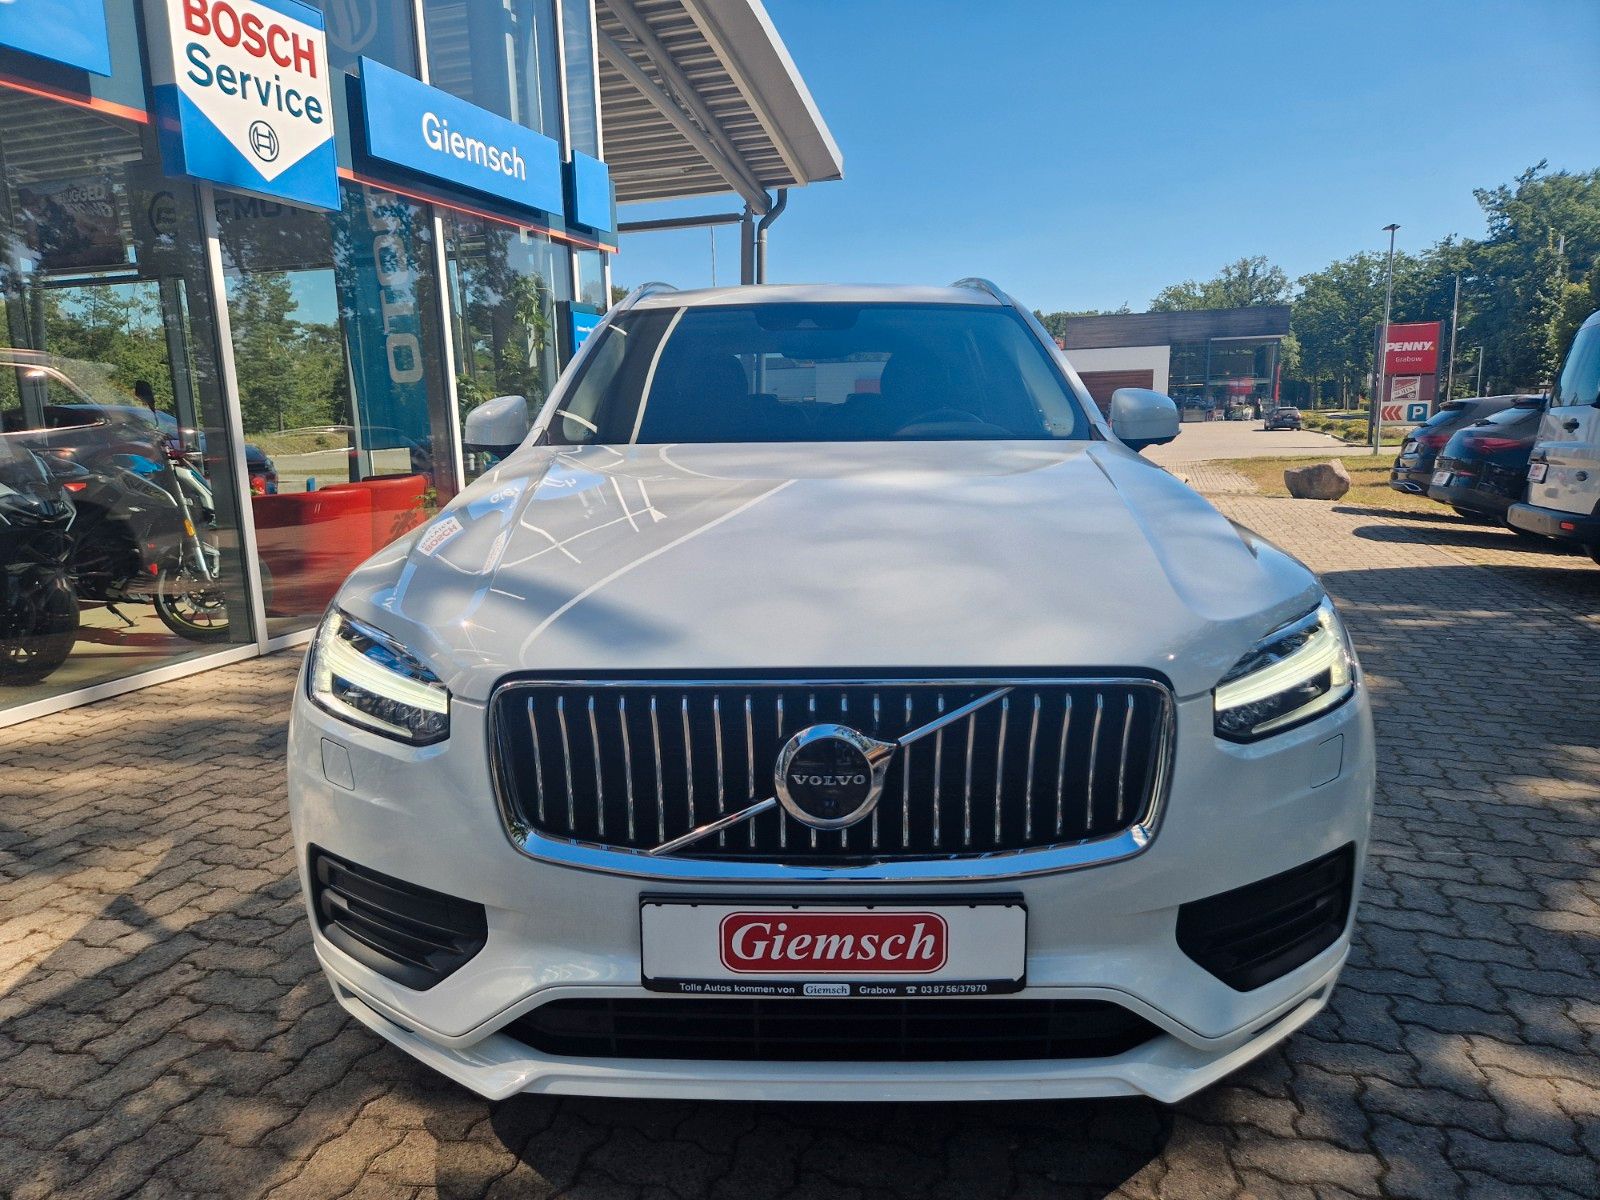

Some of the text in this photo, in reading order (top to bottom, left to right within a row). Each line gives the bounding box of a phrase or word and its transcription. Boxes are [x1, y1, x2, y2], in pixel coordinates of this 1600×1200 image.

[182, 0, 317, 79] BOSCH
[186, 42, 324, 124] Service
[422, 111, 526, 181] Giemsch
[1395, 355, 1423, 363] Grabow
[1411, 405, 1424, 419] P
[791, 774, 866, 786] VOLVO
[731, 922, 936, 960] Giemsch
[679, 982, 702, 992] Tolle
[704, 983, 732, 992] Autos
[734, 984, 775, 993] kommen
[777, 986, 795, 994] von
[805, 985, 848, 995] Giemsch
[859, 985, 897, 994] Grabow
